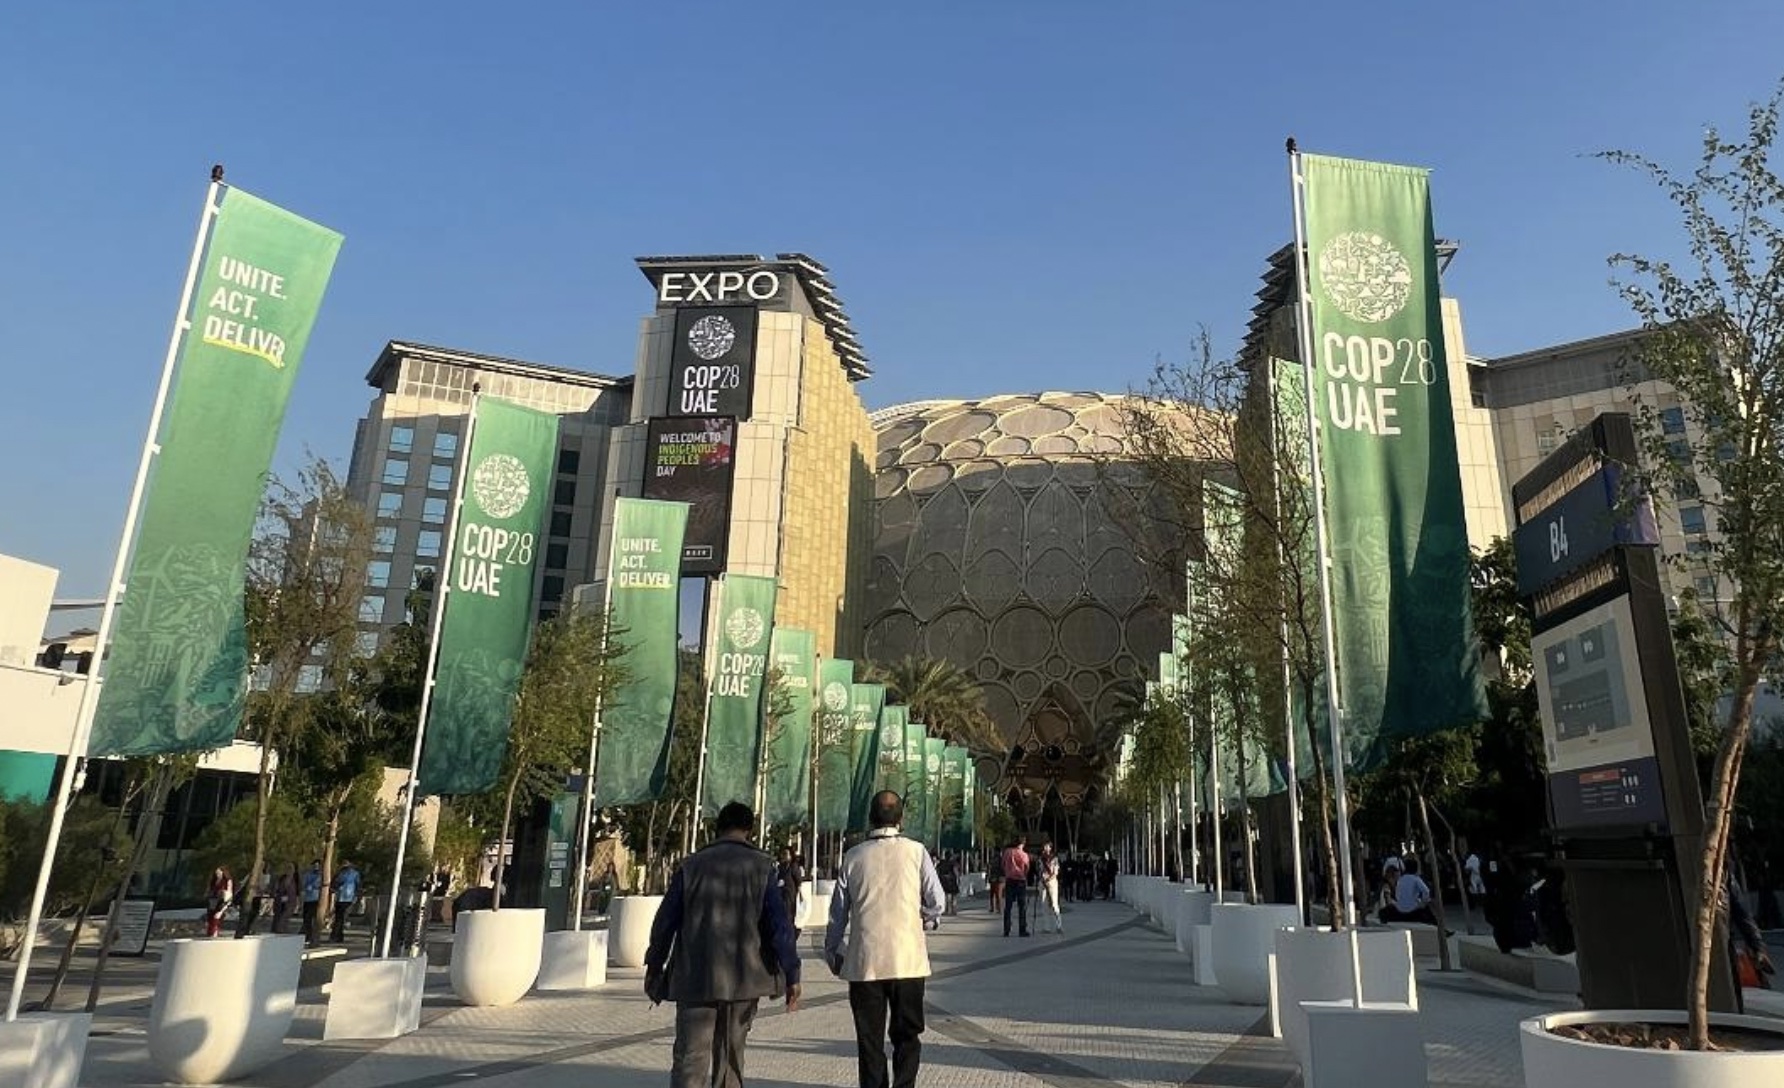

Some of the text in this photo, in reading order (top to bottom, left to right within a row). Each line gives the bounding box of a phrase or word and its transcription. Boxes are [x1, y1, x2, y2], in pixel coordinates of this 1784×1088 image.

[219, 256, 287, 300] UNITE.
[660, 271, 779, 302] EXPO
[209, 286, 259, 320] ACT.
[1324, 332, 1437, 385] COP28
[684, 365, 740, 389] COP28
[681, 390, 719, 413] UAE
[1327, 382, 1401, 435] UAE
[659, 443, 718, 455] INDIGENOUS
[660, 431, 721, 443] WELCOME TO
[656, 466, 676, 477] DAY
[463, 523, 534, 565] COP28
[621, 538, 662, 553] UNITE.
[1550, 515, 1568, 563] B4
[620, 555, 648, 570] ACT.
[458, 557, 503, 597] UAE
[718, 675, 751, 698] UAE
